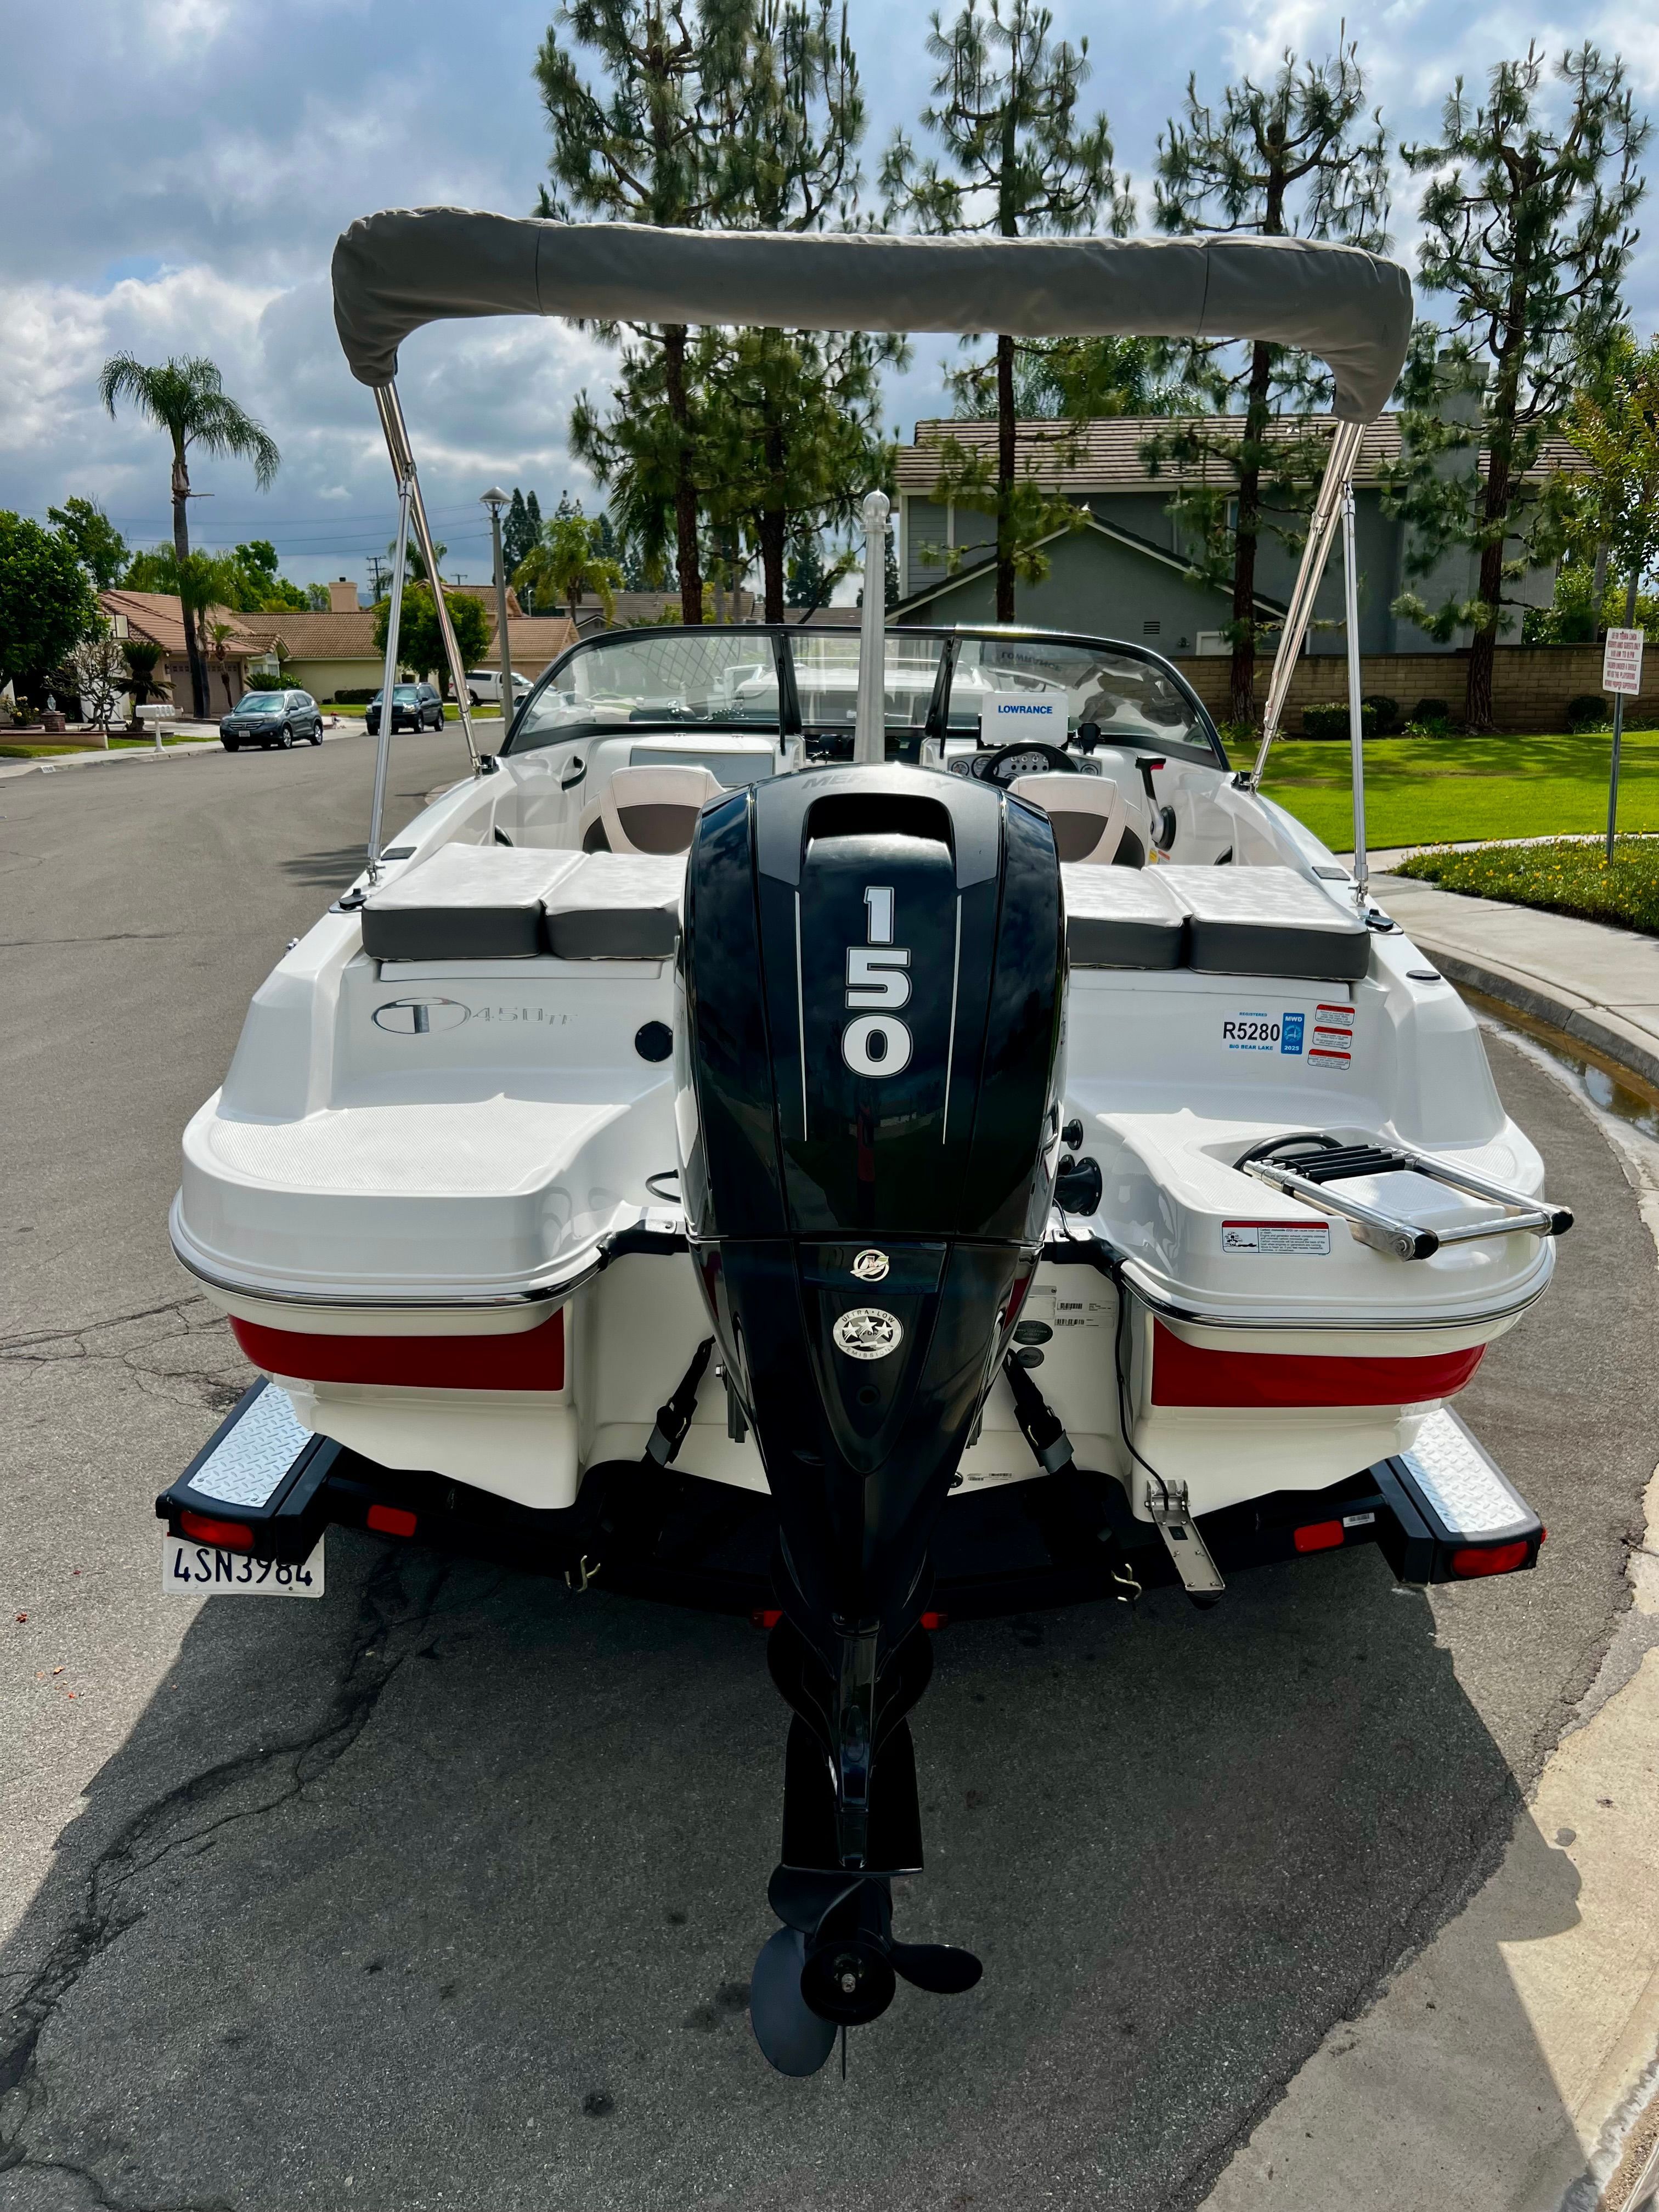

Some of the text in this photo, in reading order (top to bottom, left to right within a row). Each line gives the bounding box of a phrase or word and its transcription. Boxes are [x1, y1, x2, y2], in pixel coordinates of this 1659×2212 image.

[998, 705, 1053, 714] LOWRANCE
[841, 886, 913, 1079] 150
[1222, 1021, 1280, 1042] R5280
[877, 1311, 895, 1323] LOW
